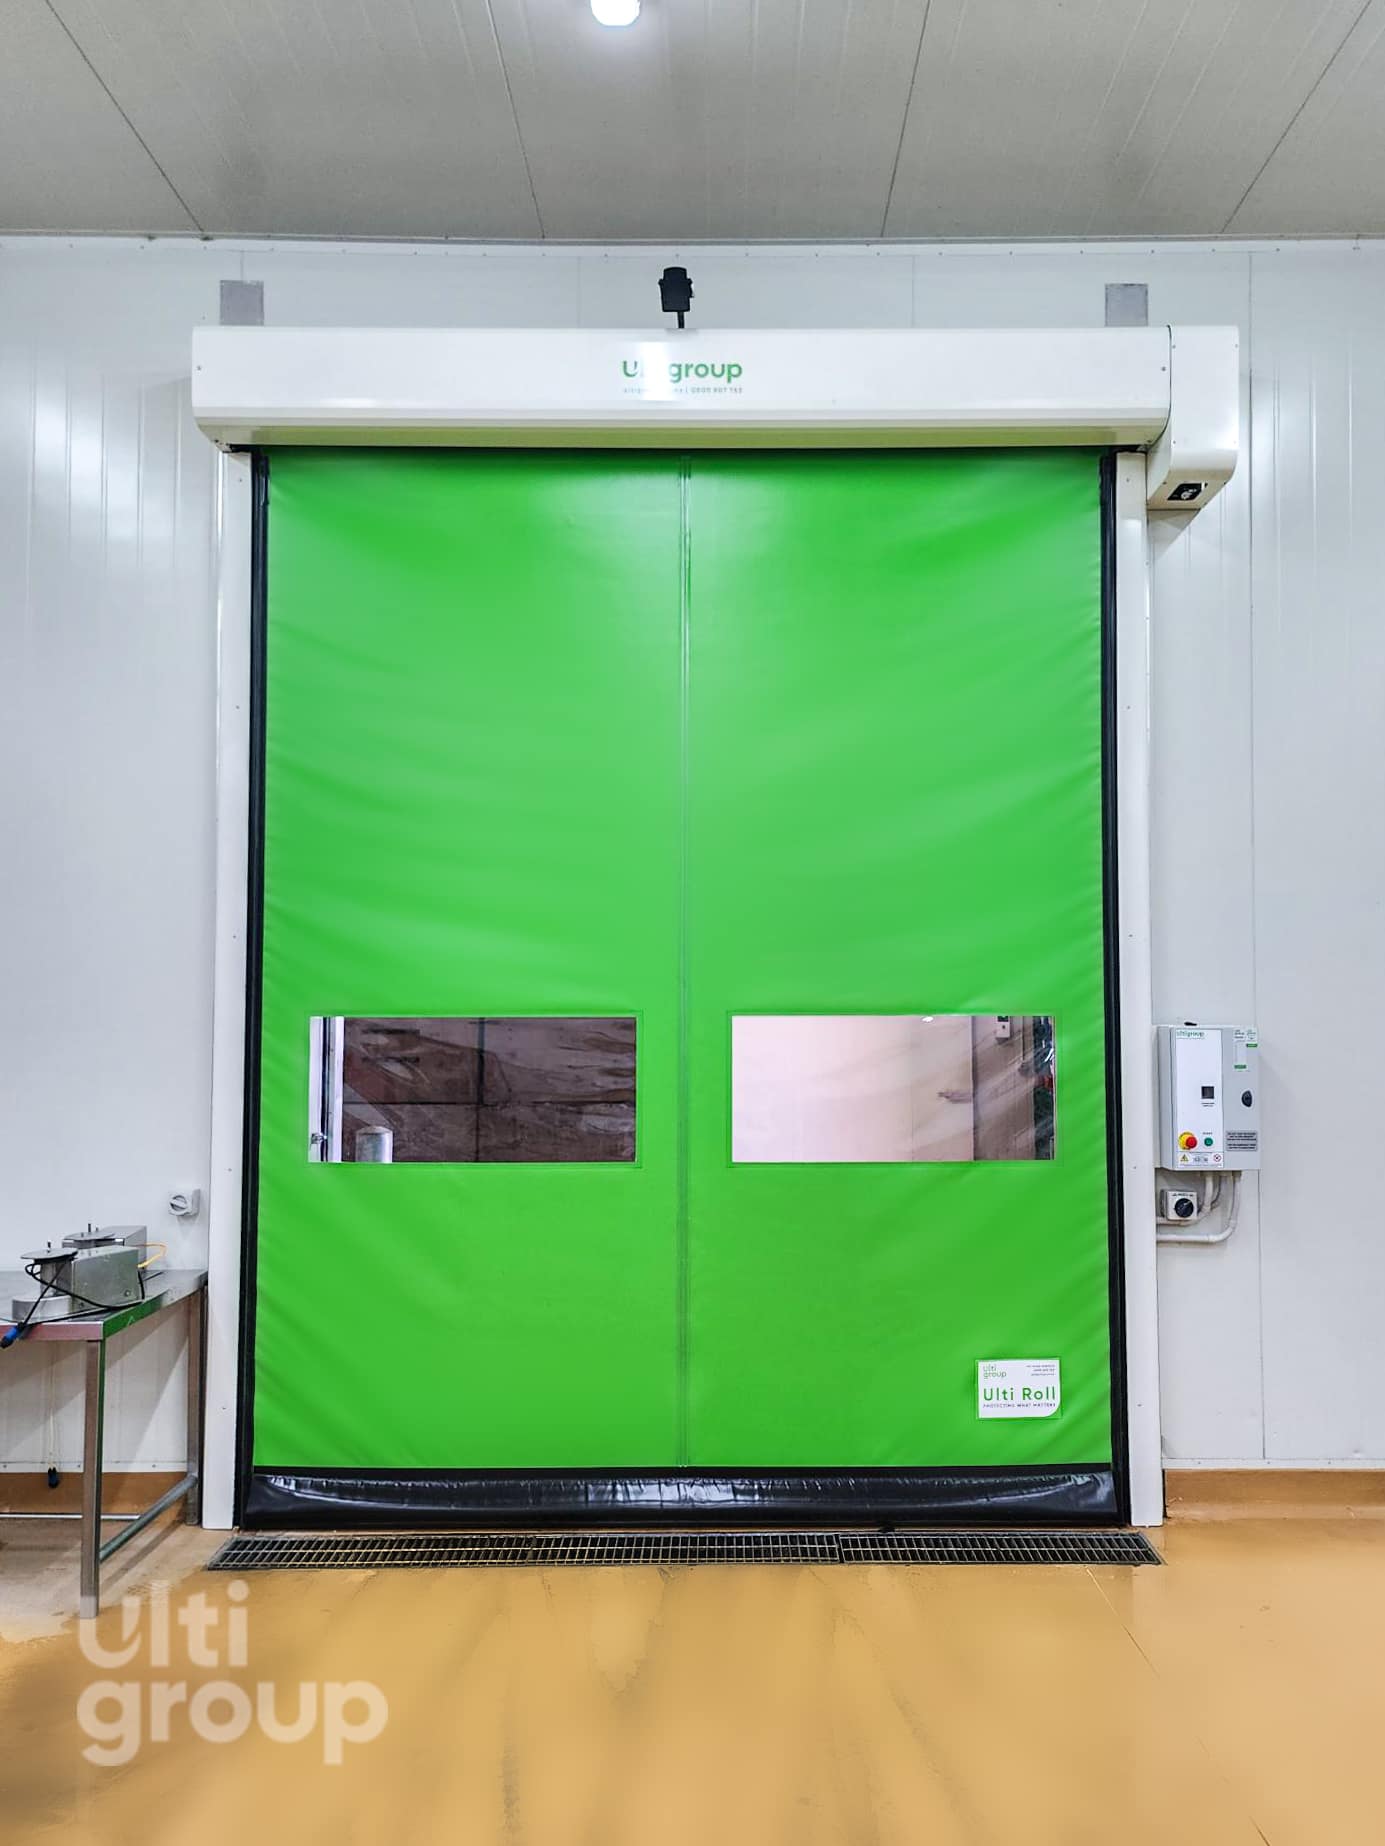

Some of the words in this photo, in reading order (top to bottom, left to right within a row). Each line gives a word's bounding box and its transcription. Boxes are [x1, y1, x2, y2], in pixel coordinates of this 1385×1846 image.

[622, 360, 743, 383] Ugroup
[983, 1371, 1007, 1380] group
[983, 1387, 1014, 1401] Ulti
[1022, 1386, 1056, 1400] Roll
